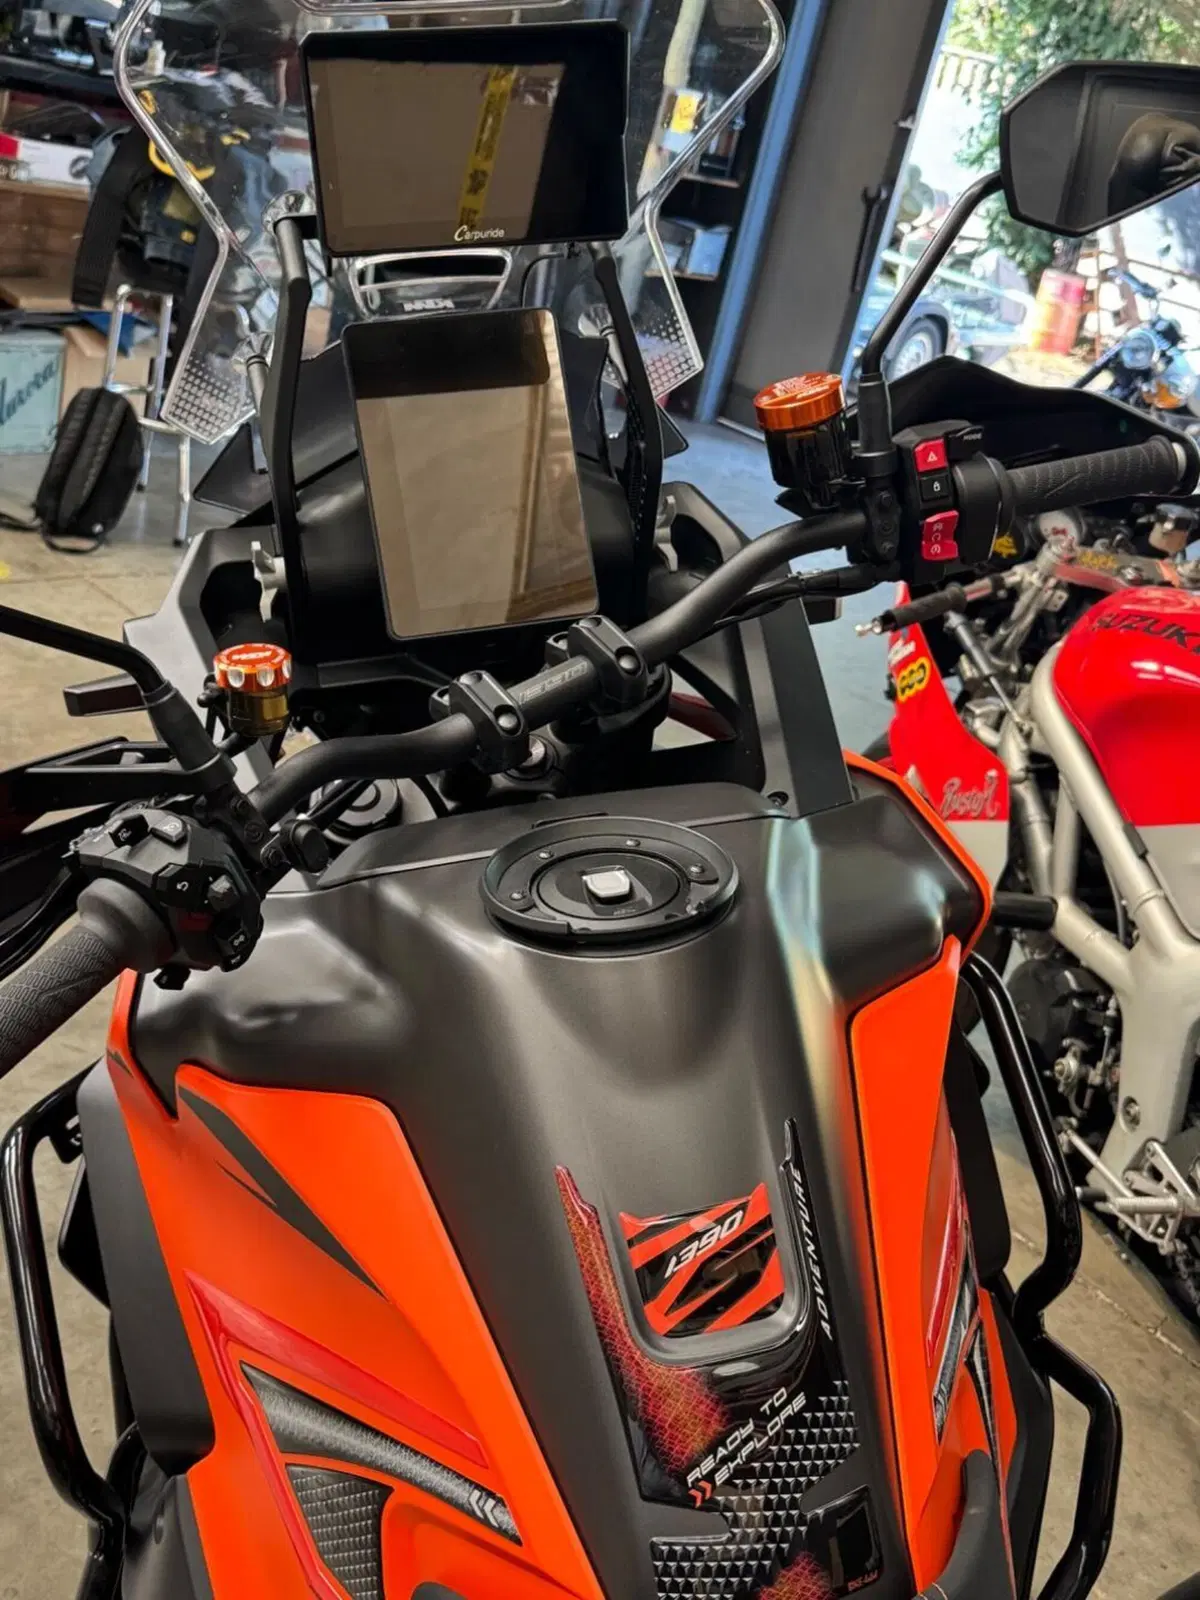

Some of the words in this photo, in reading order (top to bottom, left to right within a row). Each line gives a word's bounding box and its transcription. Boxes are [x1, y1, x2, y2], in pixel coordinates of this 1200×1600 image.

[454, 225, 505, 241] Carpuride
[664, 1209, 744, 1279] 1390
[789, 1161, 833, 1342] ADVENTURE
[686, 1417, 755, 1488] READY
[760, 1386, 788, 1415] TO
[714, 1391, 807, 1487] EXPLORE
